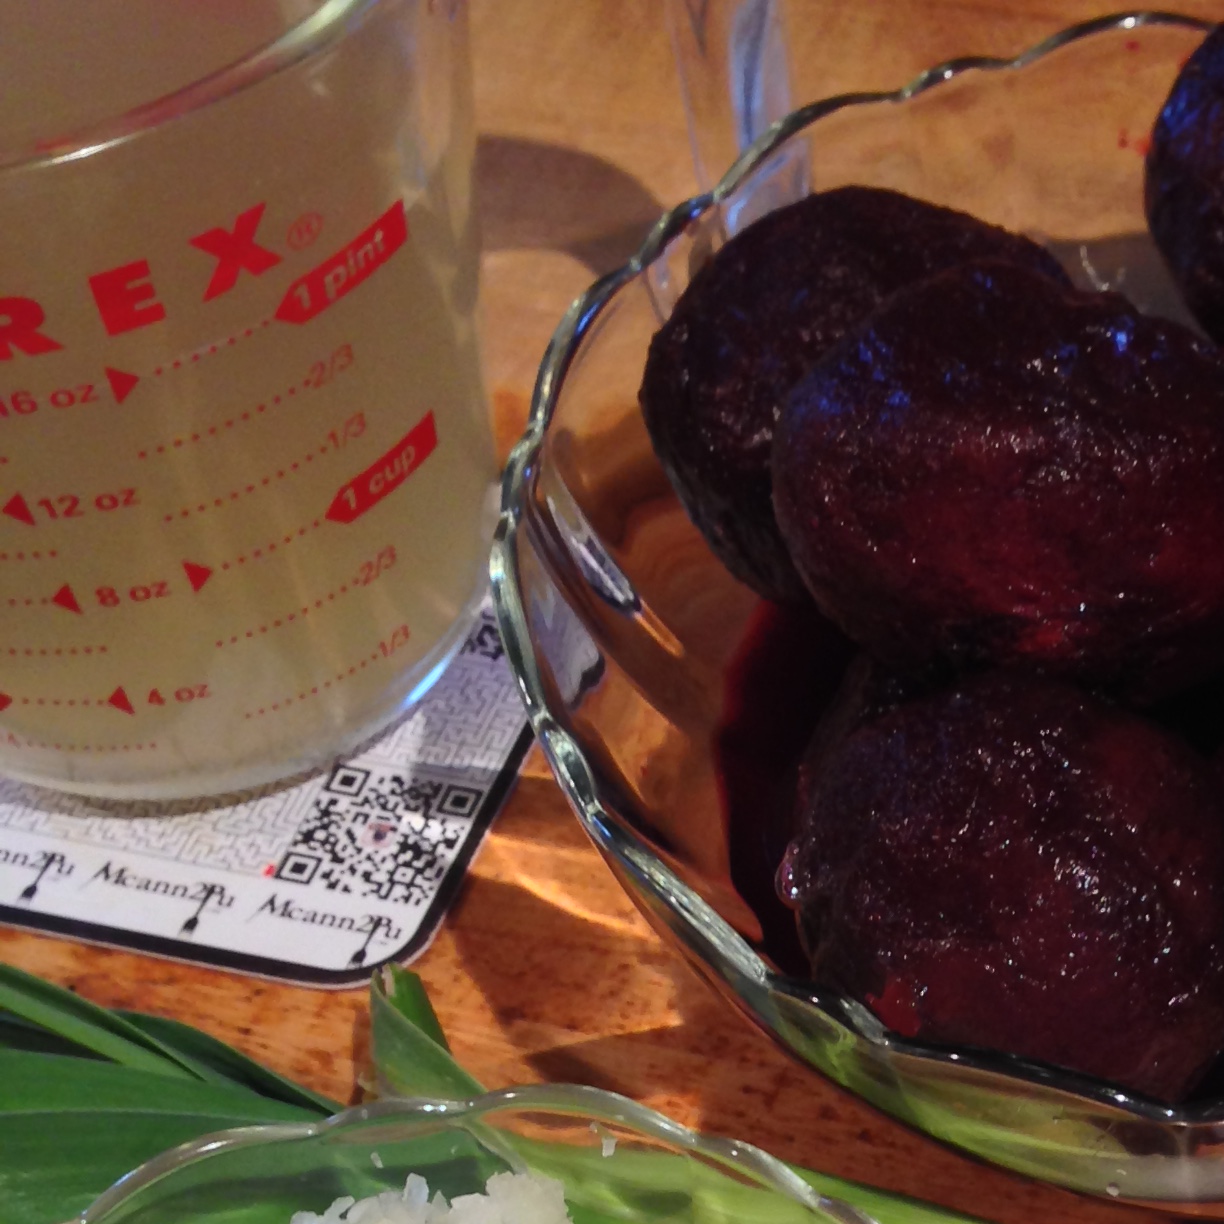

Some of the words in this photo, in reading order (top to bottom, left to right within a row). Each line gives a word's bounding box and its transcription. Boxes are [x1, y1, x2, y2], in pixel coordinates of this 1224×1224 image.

[293, 282, 313, 310] 1
[323, 228, 385, 302] pint
[309, 343, 354, 388] 2/3
[49, 384, 99, 409] oz
[327, 410, 367, 449] 1/3
[342, 486, 357, 511] 1
[368, 445, 416, 495] cup
[38, 493, 85, 520] 12
[94, 487, 141, 512] oz
[362, 545, 397, 587] 2/3
[95, 585, 121, 608] 8
[129, 580, 171, 602] oz
[174, 683, 212, 703] oz
